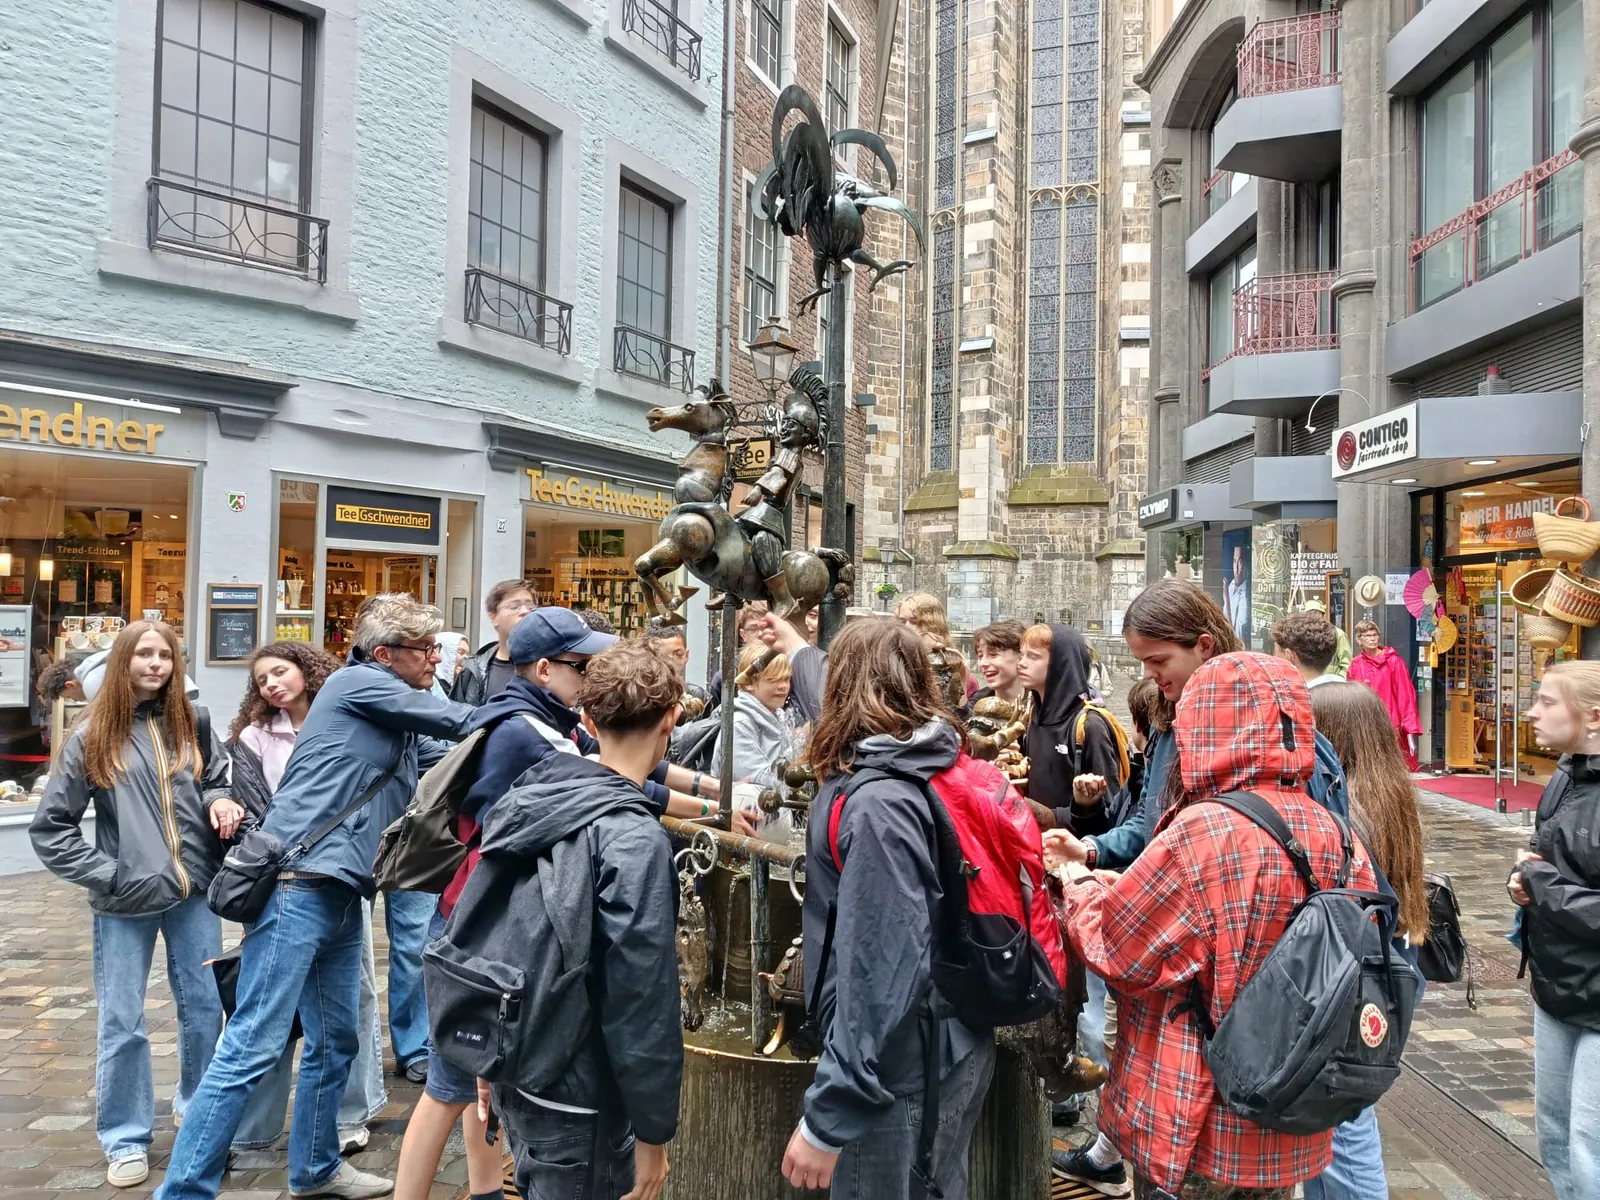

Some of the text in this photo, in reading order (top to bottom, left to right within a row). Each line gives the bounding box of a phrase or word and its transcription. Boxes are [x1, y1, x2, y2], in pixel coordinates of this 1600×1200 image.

[1359, 417, 1408, 450] CONTIGO
[733, 447, 765, 464] ee
[1357, 440, 1408, 466] fairtrade shop
[526, 469, 674, 519] TeeGschwendn
[338, 507, 428, 527] Tee Gschwendner
[1139, 498, 1169, 519] OLYMP
[1460, 497, 1556, 526] FAIRER HANDEL
[498, 520, 506, 530] 27
[57, 545, 120, 556] Trend-Edition
